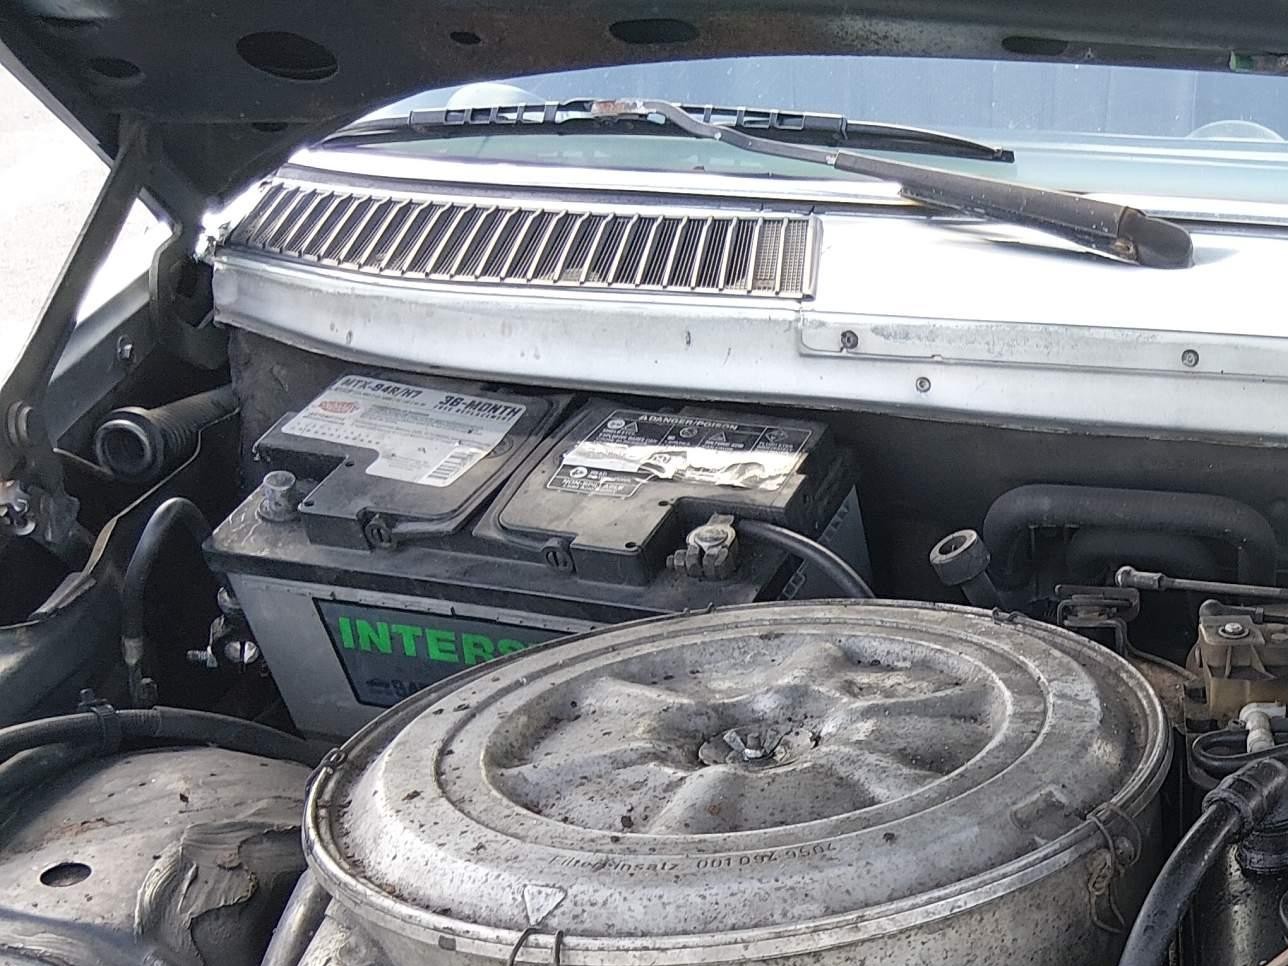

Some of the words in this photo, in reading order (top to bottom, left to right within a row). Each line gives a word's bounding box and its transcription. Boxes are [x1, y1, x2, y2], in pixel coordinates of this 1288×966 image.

[439, 395, 523, 417] 36-MONTH
[650, 415, 739, 431] DANGER/POISON
[696, 856, 731, 870] 001
